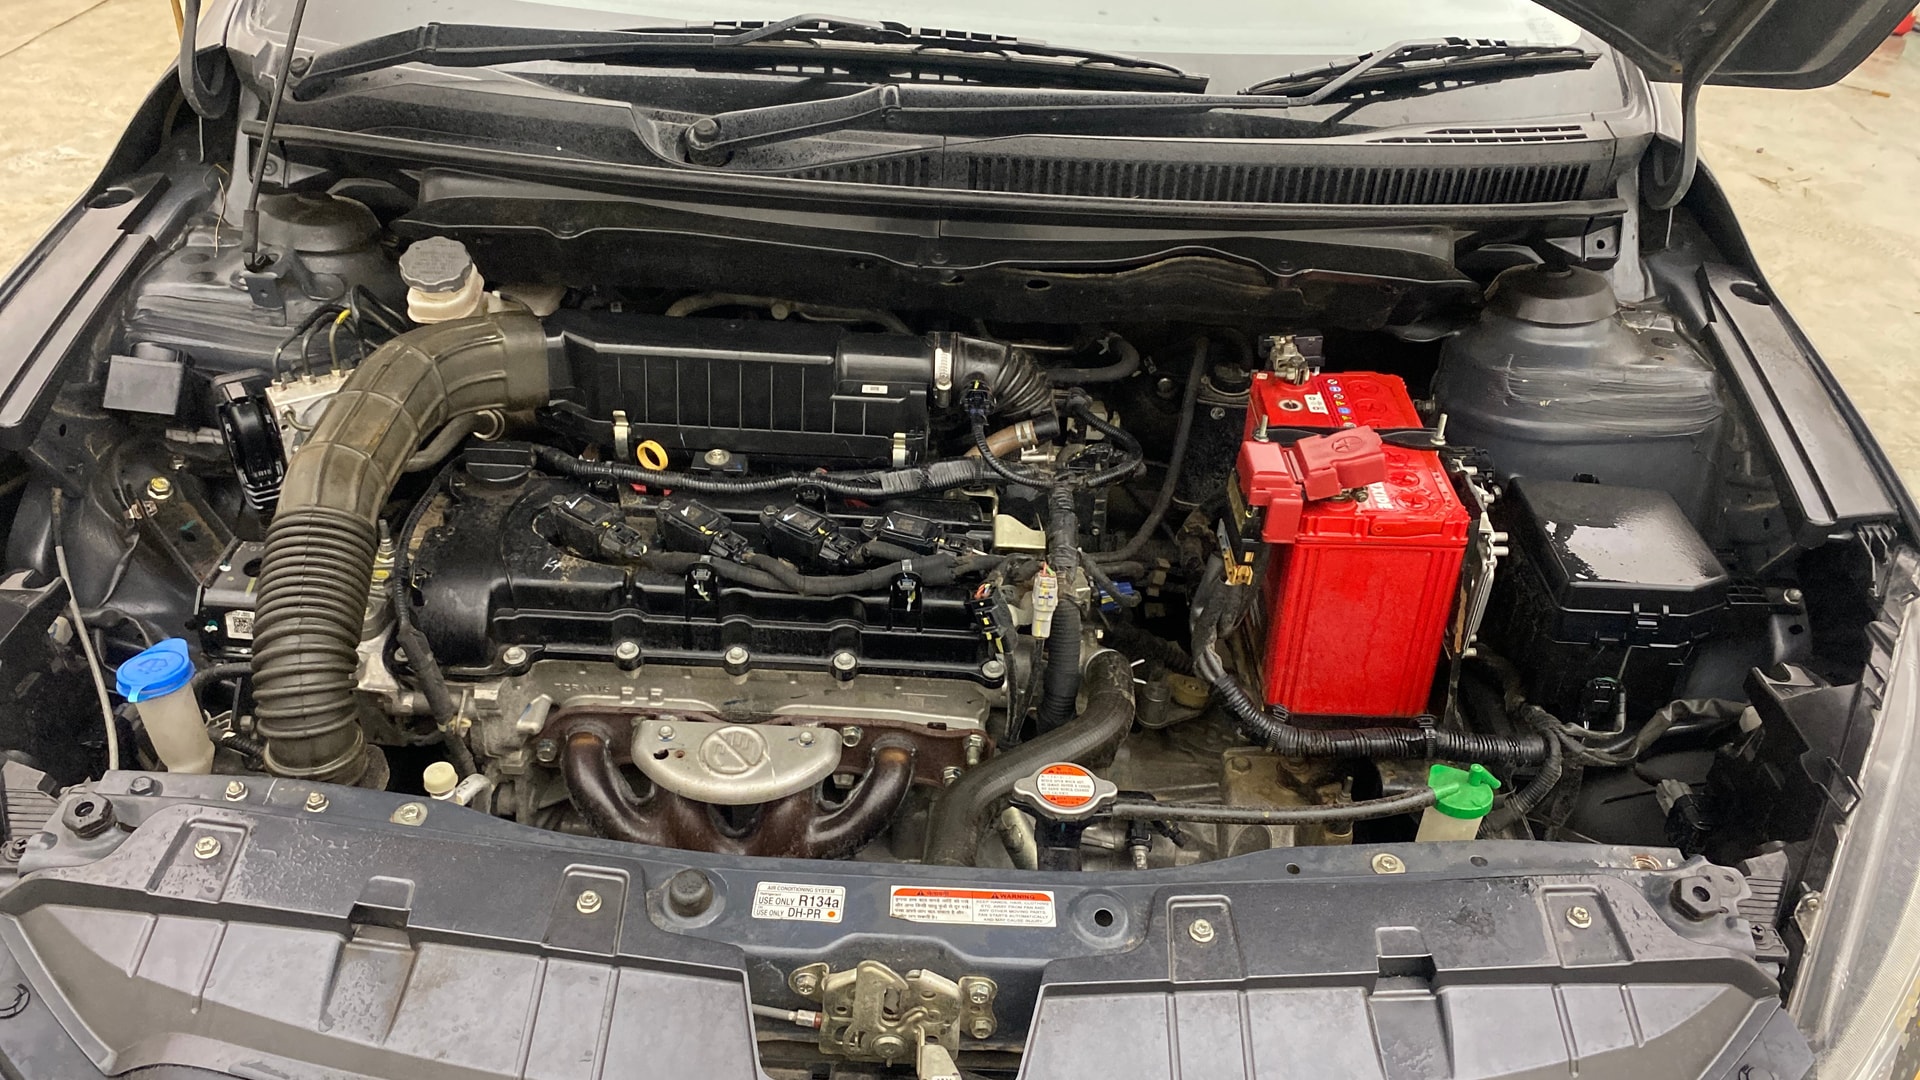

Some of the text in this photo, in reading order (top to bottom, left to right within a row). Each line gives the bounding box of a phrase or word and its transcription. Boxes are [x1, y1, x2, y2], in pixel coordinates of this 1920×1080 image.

[1369, 482, 1394, 509] XIDE
[758, 895, 839, 908] USE ONLY R134a
[769, 909, 784, 917] ONLY
[787, 907, 821, 919] DH-PR
